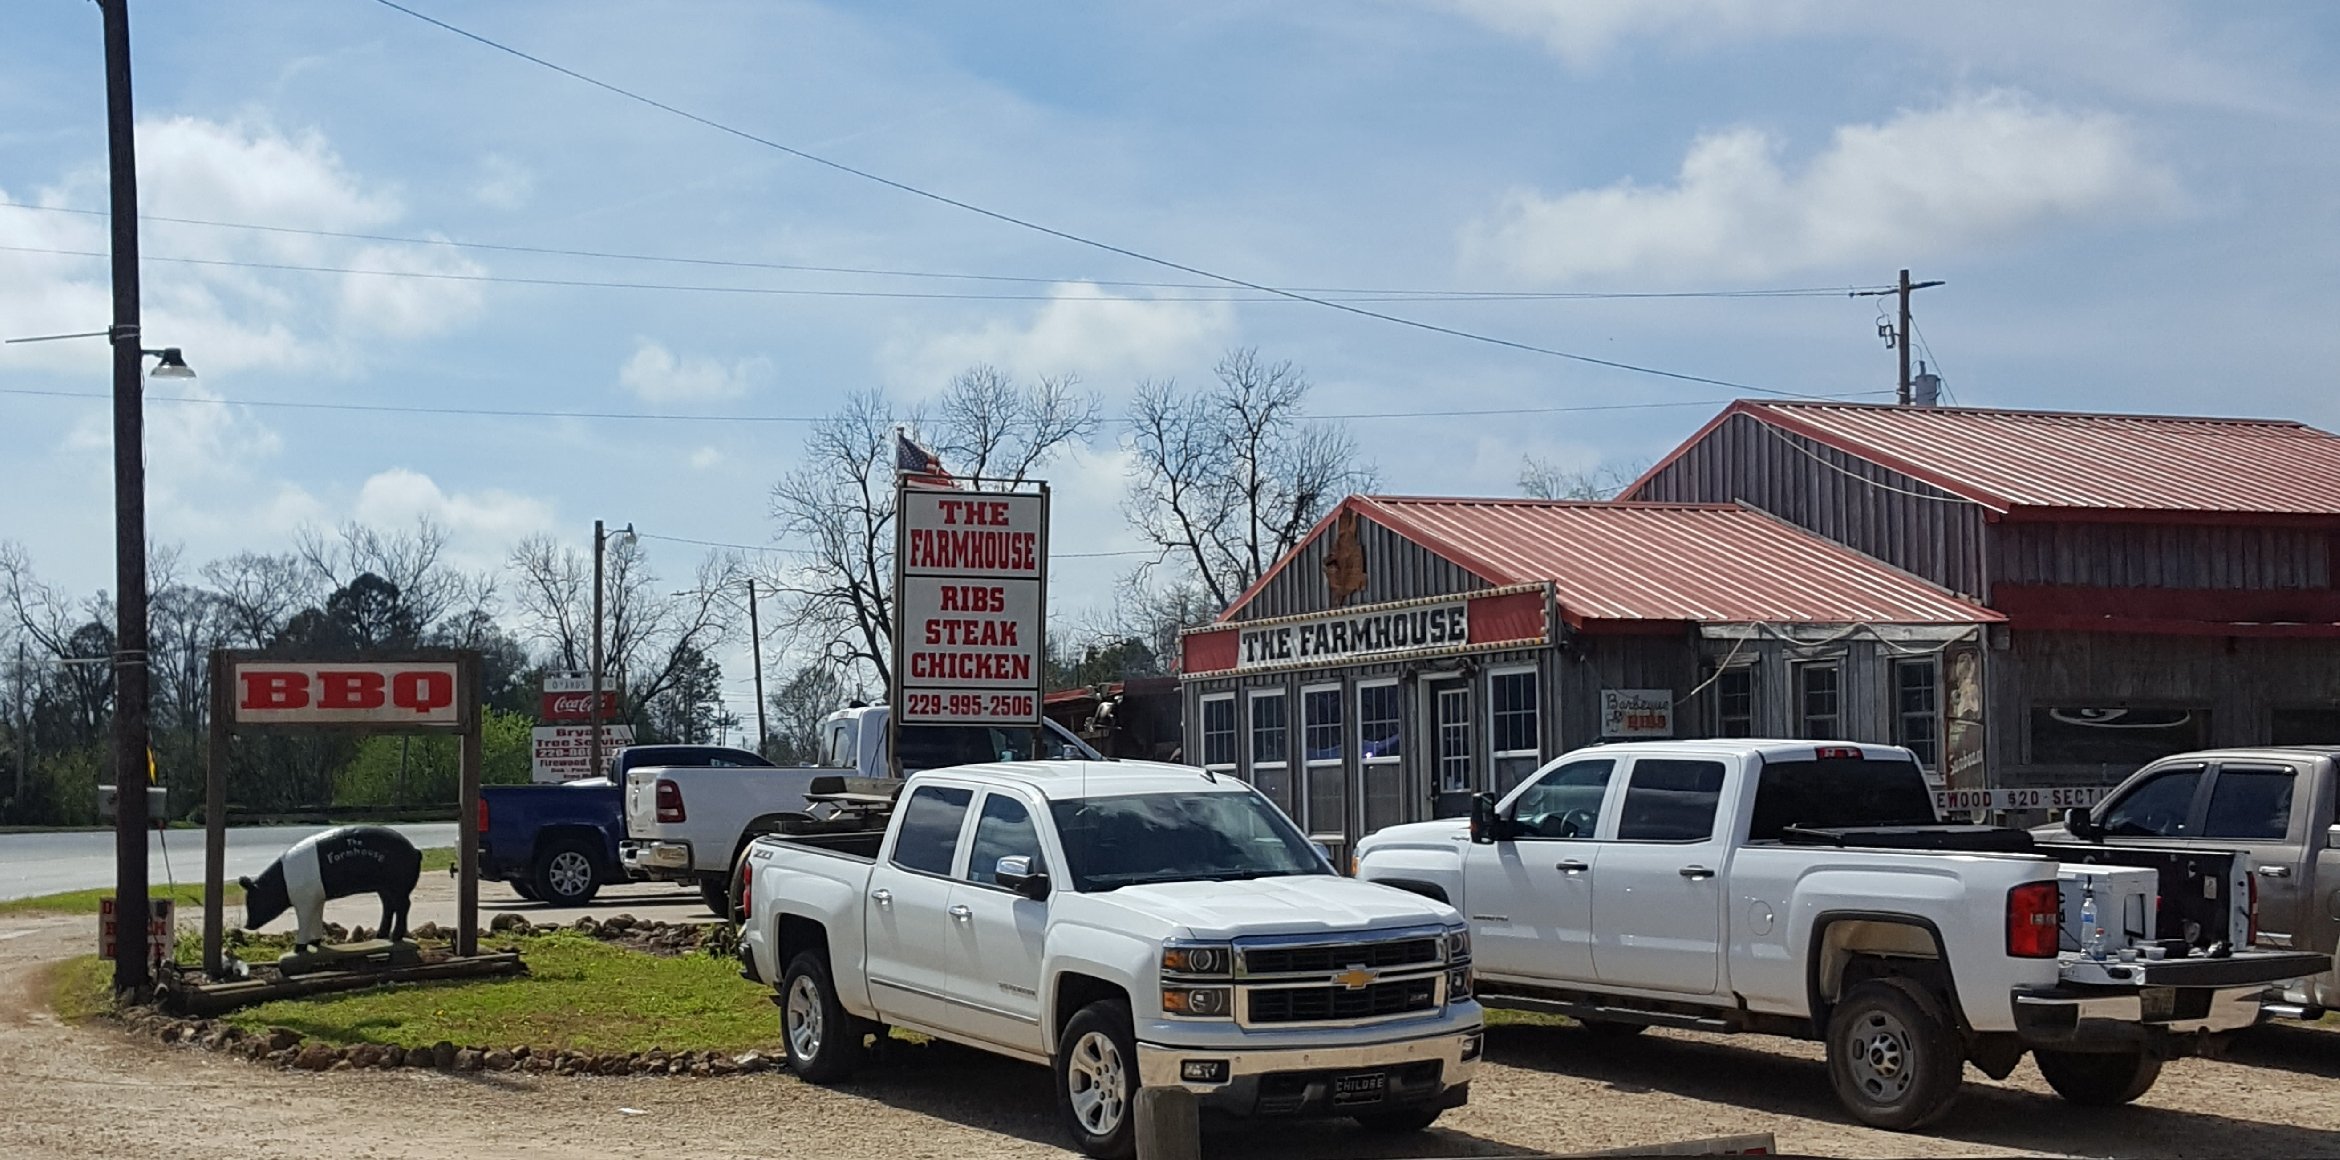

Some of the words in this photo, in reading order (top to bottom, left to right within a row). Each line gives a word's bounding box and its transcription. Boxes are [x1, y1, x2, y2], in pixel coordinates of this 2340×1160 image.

[938, 500, 1009, 526] THE
[910, 529, 1035, 570] FARMHOUSE
[940, 586, 1005, 612] RIBS
[925, 619, 1018, 646] STEAK
[1242, 627, 1291, 662] THE
[1300, 606, 1466, 656] FARMHOUSE
[911, 653, 1030, 679] CHICKEN
[241, 671, 452, 713] BBQ
[908, 694, 1032, 716] 229-995-2506
[536, 739, 570, 747] Tree
[574, 738, 633, 746] Sevice
[556, 728, 611, 737] Bryat
